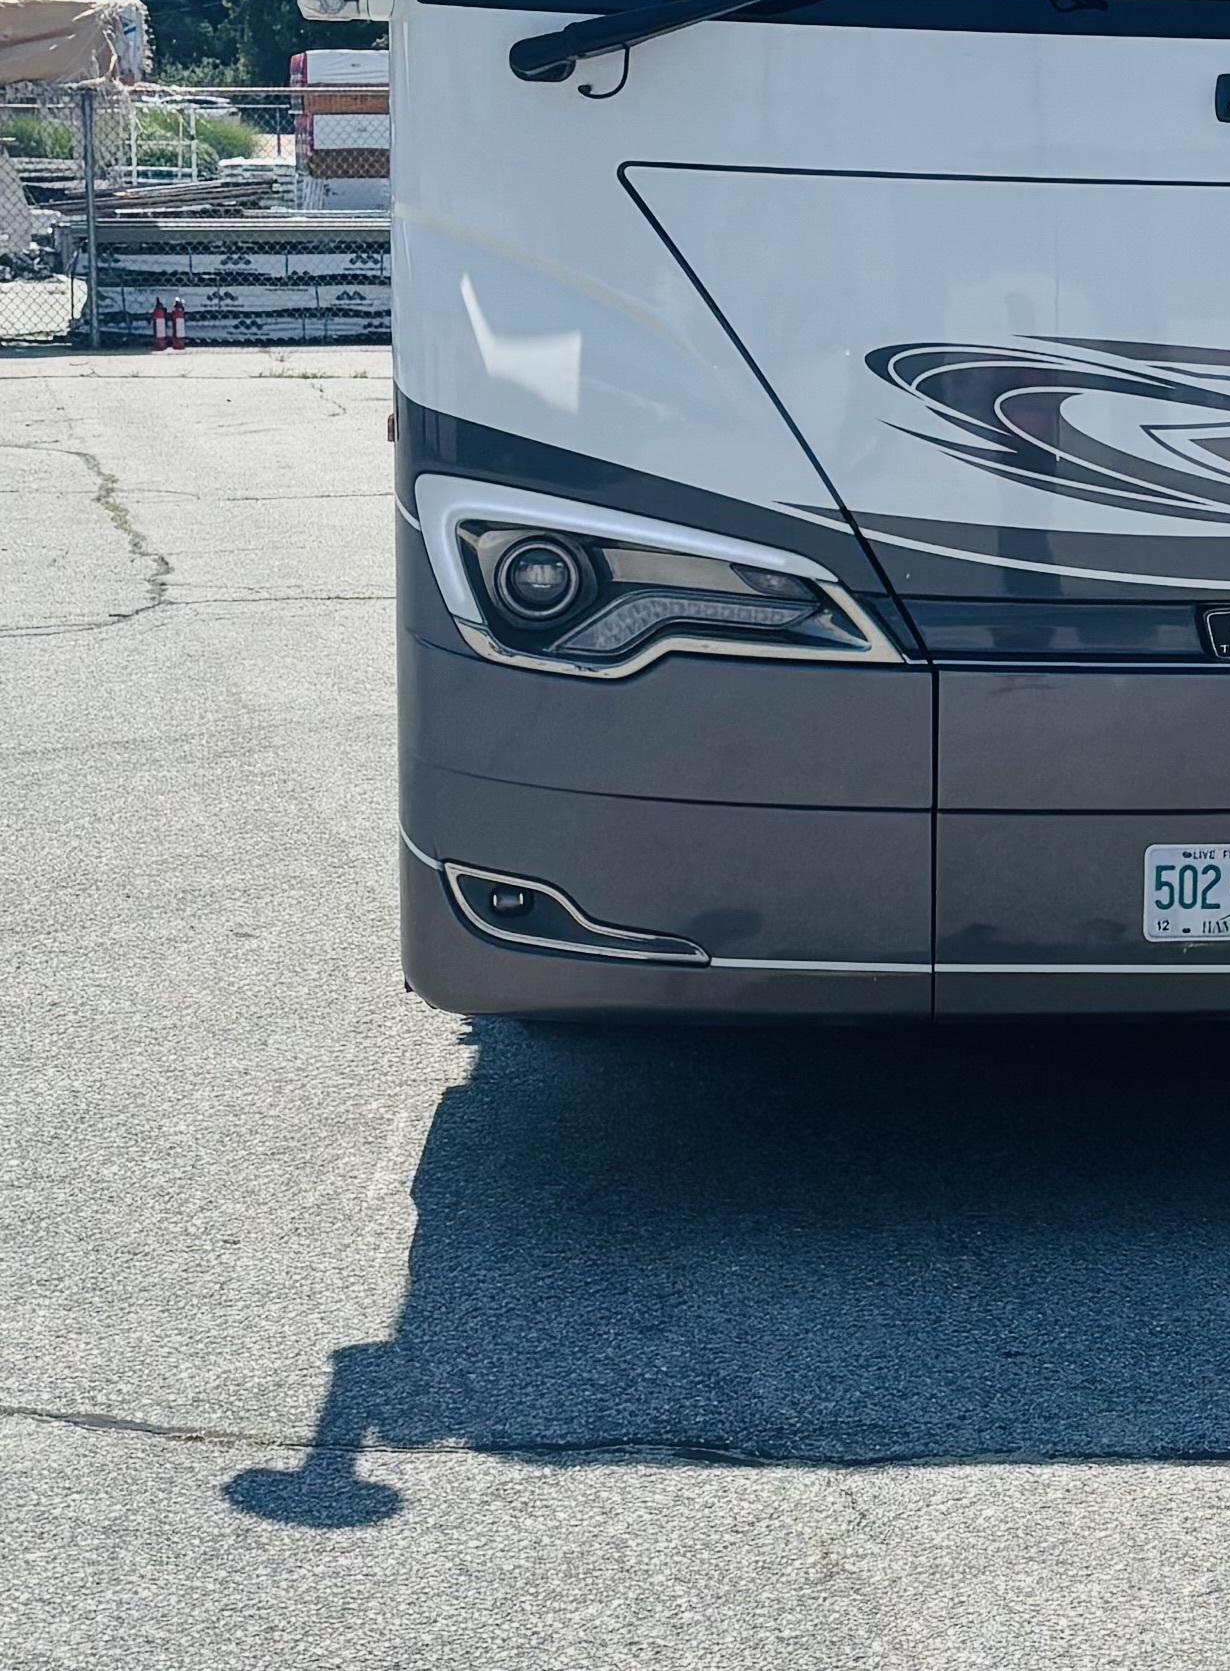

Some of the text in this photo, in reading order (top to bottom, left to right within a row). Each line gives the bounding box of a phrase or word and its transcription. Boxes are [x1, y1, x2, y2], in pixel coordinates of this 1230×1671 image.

[1193, 849, 1216, 860] LIVE
[1154, 864, 1222, 910] 502
[1156, 919, 1171, 932] 12
